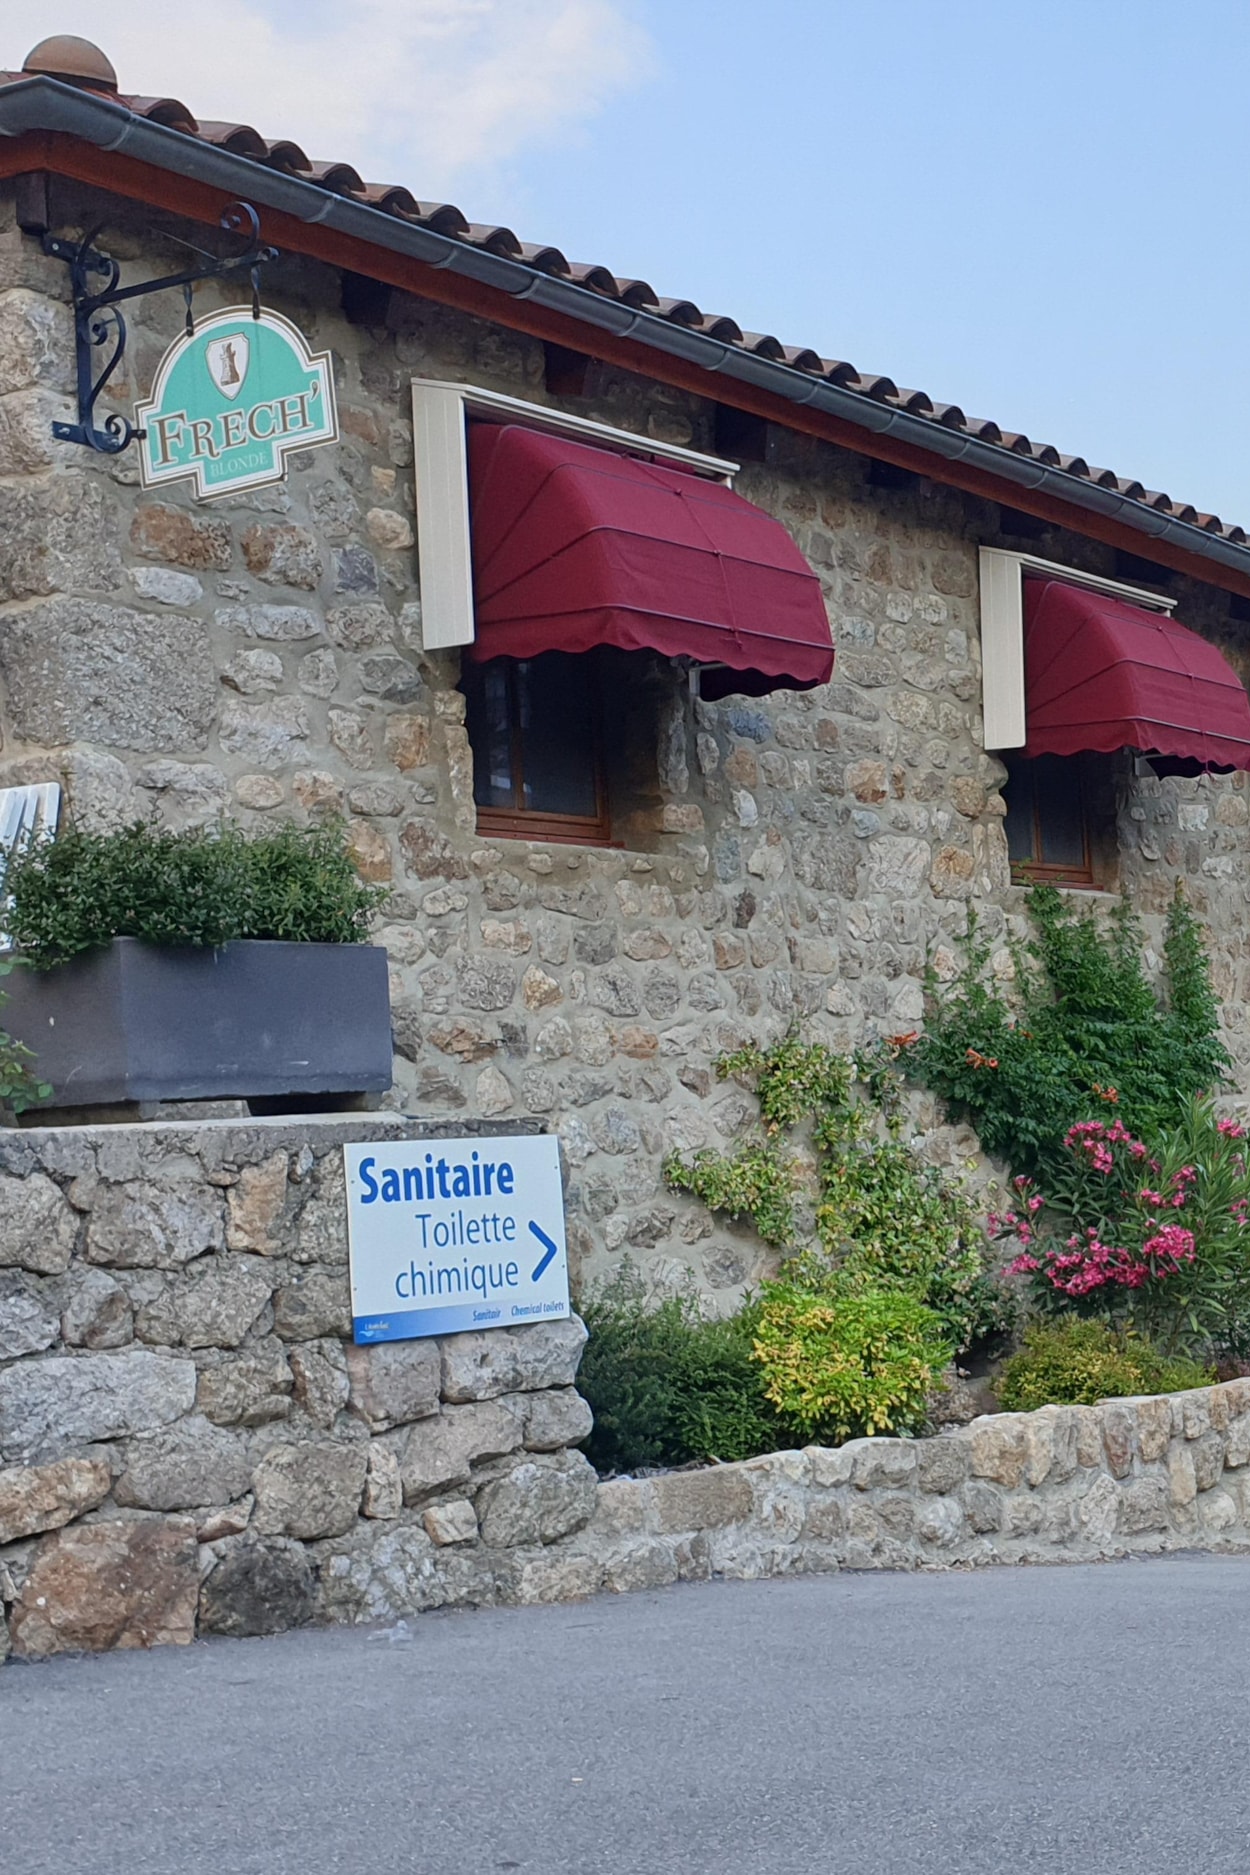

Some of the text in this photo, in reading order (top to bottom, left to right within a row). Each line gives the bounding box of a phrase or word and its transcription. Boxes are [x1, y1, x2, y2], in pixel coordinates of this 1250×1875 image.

[211, 452, 268, 477] BLONDE
[359, 1151, 514, 1204] Sanitaire
[415, 1210, 516, 1248] Toilette
[395, 1258, 519, 1298] chimique
[472, 1308, 501, 1322] Sanitair
[511, 1301, 565, 1317] Chemical toilets
